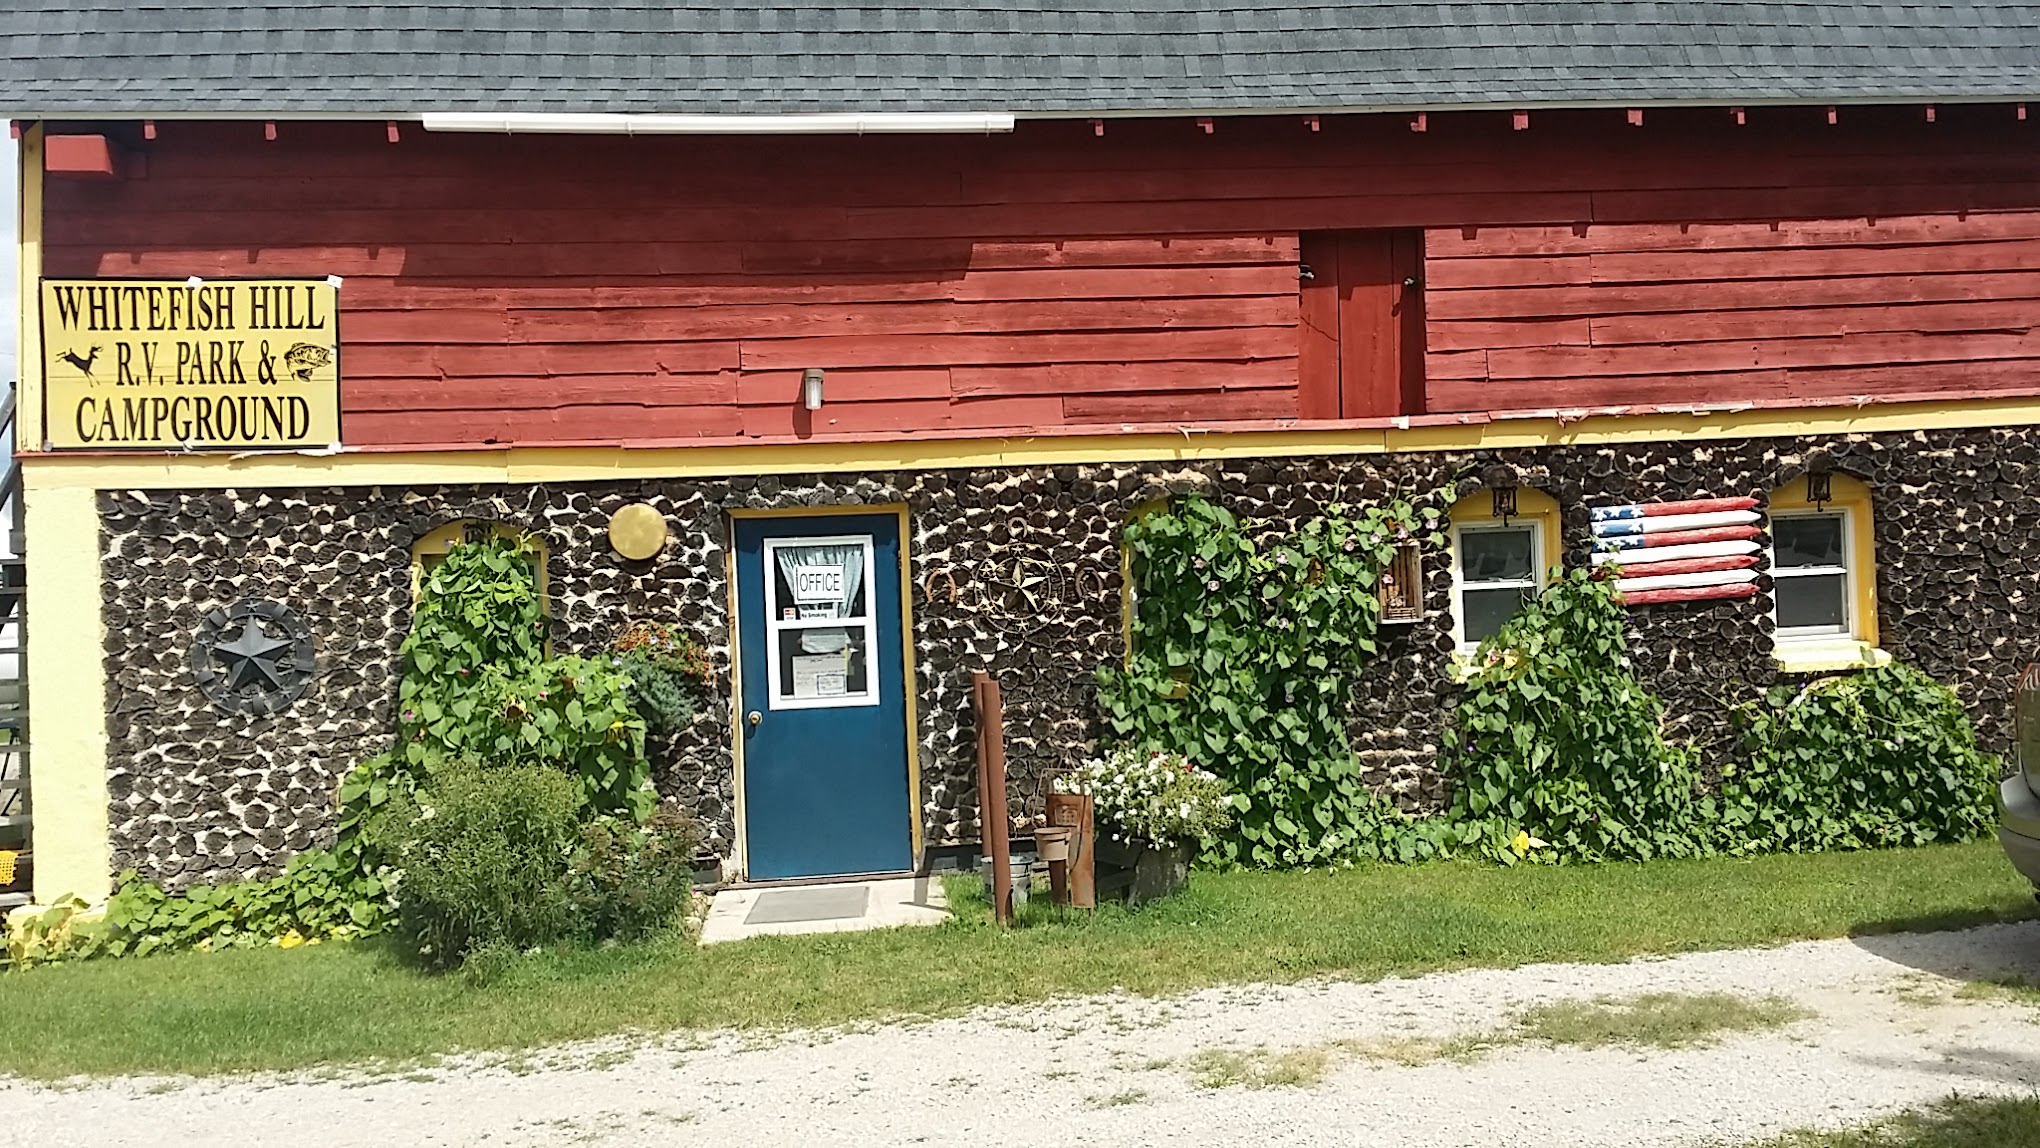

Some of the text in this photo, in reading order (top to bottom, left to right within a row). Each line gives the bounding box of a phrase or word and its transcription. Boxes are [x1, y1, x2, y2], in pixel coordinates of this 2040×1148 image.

[53, 286, 325, 331] WHITEFISH HILL
[115, 339, 278, 386] R.V. PARK &
[75, 395, 310, 443] CAMPGROUND
[799, 573, 841, 592] OFFICE
